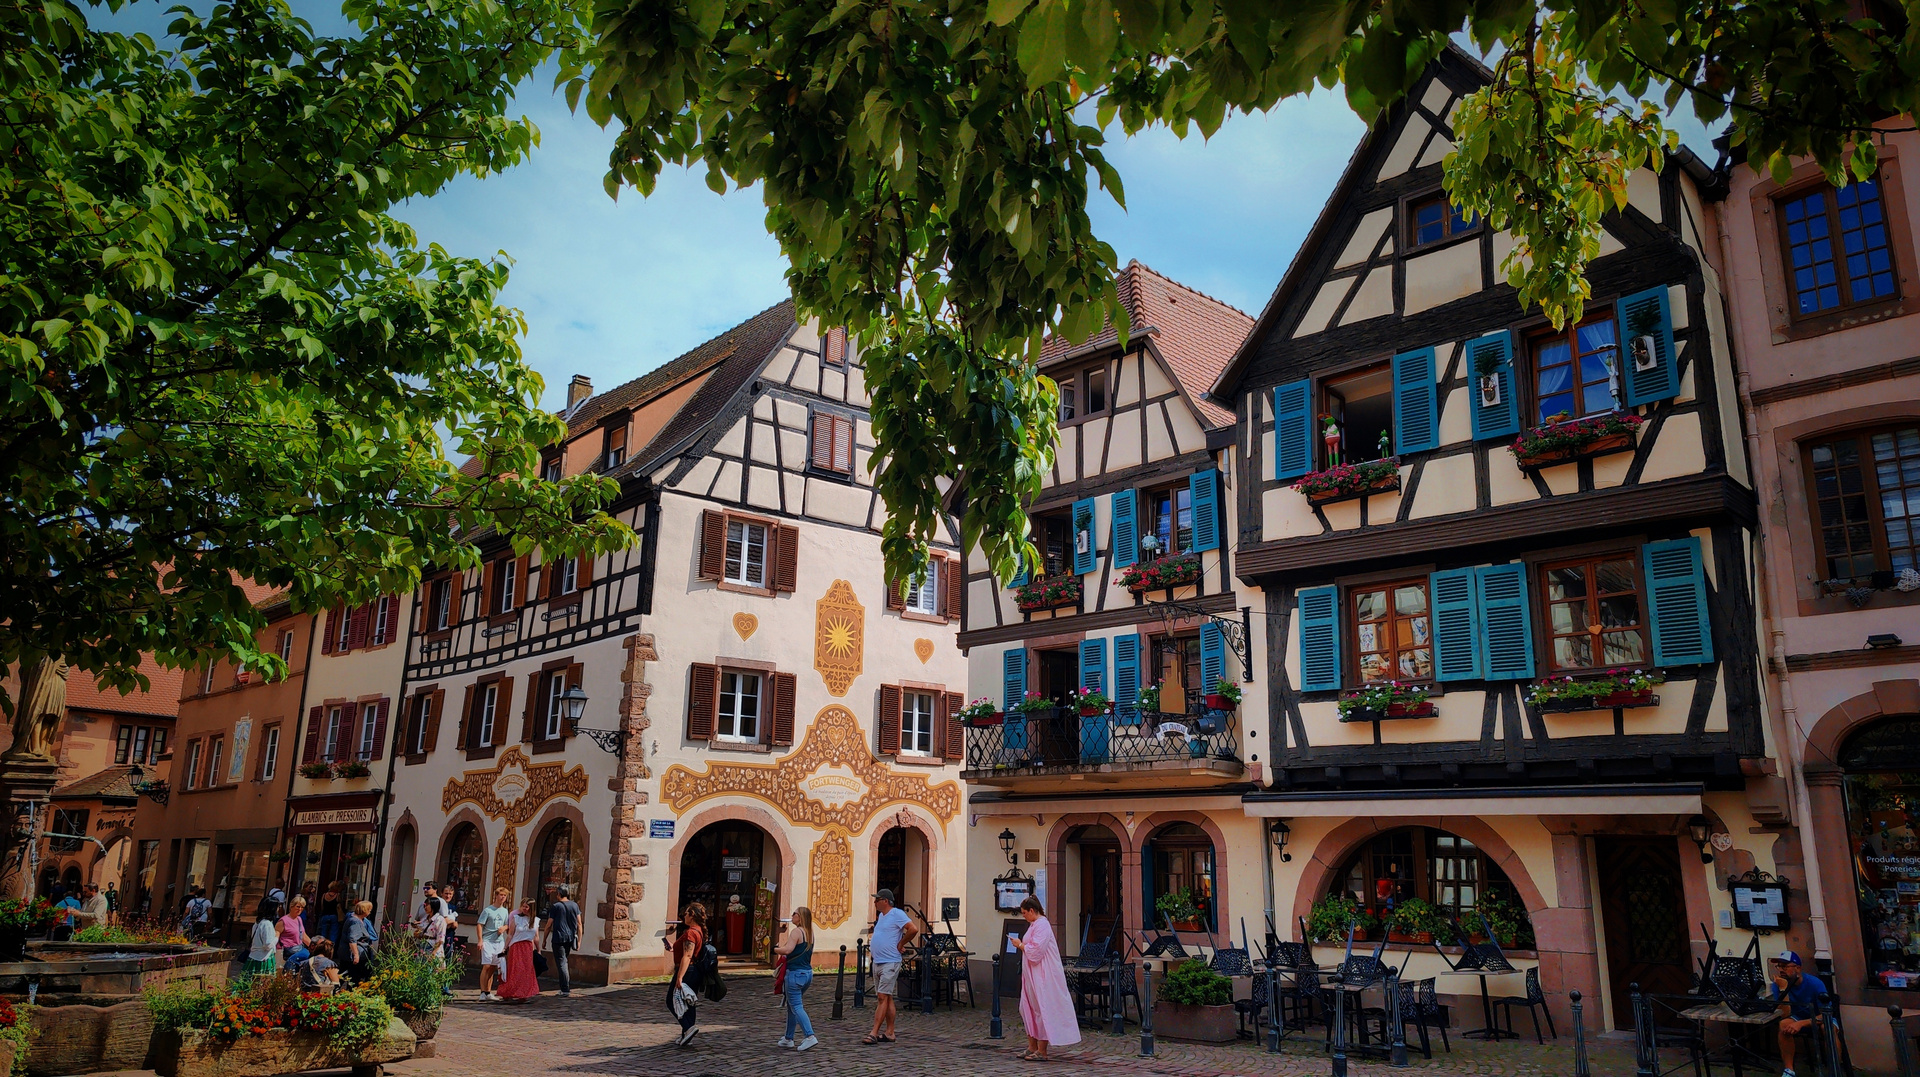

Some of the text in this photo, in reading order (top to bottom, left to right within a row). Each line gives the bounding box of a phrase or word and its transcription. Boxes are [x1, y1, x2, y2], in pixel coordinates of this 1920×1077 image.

[808, 775, 861, 793] FORTWENGER
[301, 809, 367, 823] ALAMBICS et PRESSOIRS
[1866, 855, 1900, 863] Produits
[1884, 865, 1917, 873] Poteries
